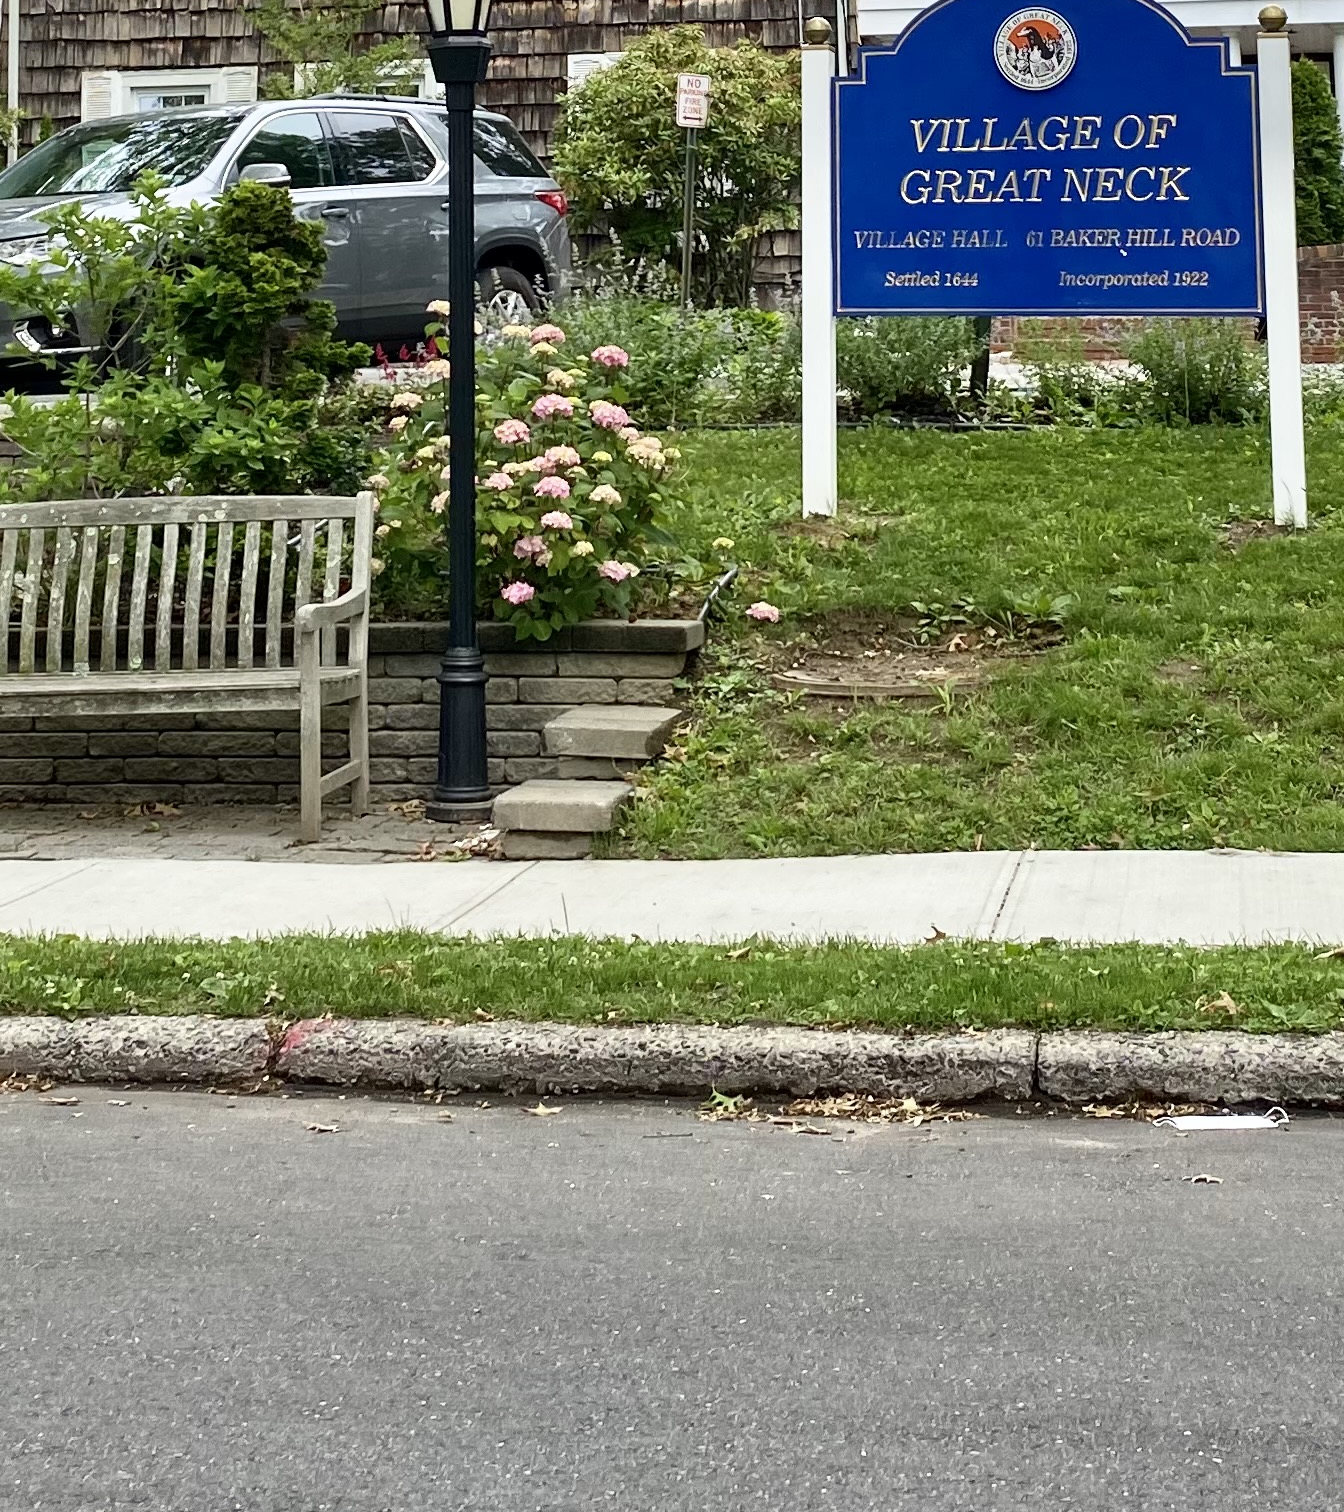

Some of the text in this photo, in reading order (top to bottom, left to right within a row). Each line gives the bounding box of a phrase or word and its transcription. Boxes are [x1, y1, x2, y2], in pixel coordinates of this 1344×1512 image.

[1023, 12, 1051, 21] GREAT
[687, 78, 702, 88] NO
[682, 105, 703, 115] ZONE
[684, 97, 702, 106] FIRE
[909, 114, 1178, 153] VILLAGE OF
[900, 166, 1192, 205] GREAT NECK
[854, 227, 1241, 249] VILLAGE HALL 61 BAKER HILL ROAD
[884, 270, 979, 288] Settled 1644
[1058, 270, 1210, 290] Incorporated 1922
